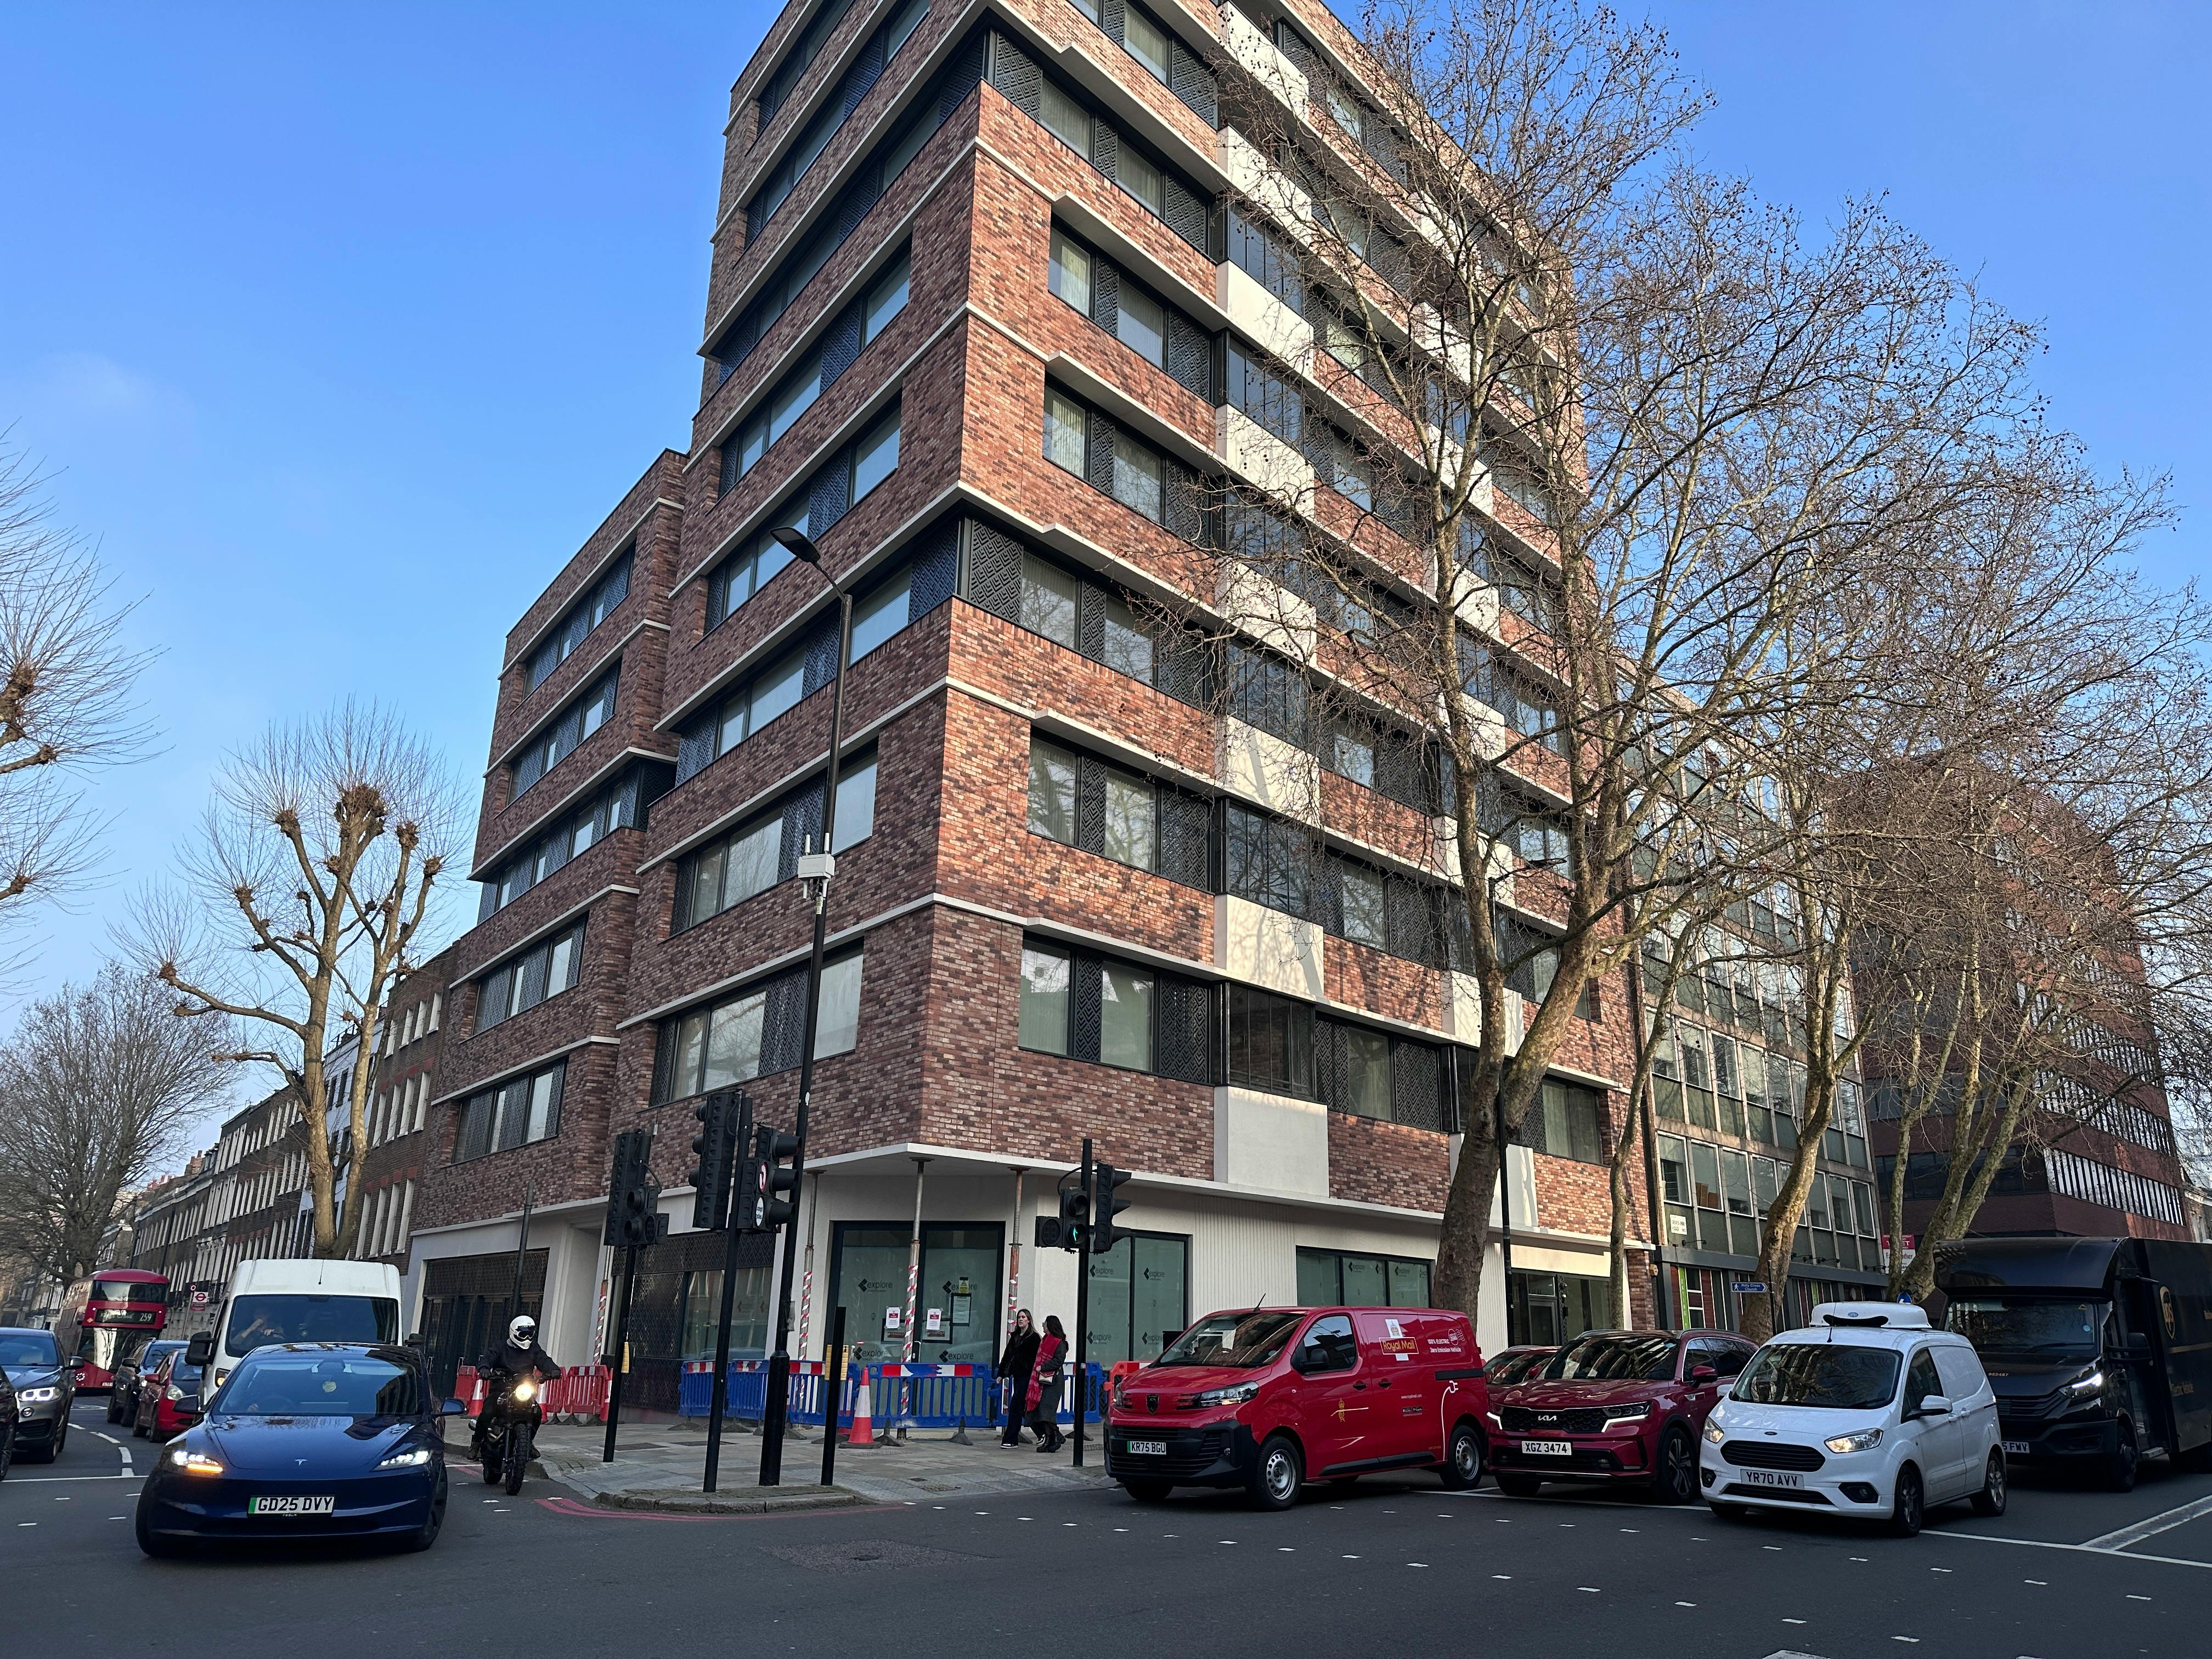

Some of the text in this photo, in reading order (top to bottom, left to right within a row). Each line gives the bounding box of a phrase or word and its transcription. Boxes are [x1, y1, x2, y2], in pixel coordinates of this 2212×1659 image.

[1095, 1267, 1114, 1275] explore
[867, 1280, 893, 1290] explore
[139, 1313, 152, 1322] 259
[1093, 1334, 1111, 1342] explore
[1382, 1339, 1416, 1351] Royal Mail
[861, 1349, 889, 1358] explore
[948, 1351, 974, 1360] explore
[1131, 1442, 1165, 1453] KR75 BGU
[1525, 1443, 1567, 1453] XGZ 3474
[2010, 1443, 2027, 1452] FWV
[1746, 1471, 1797, 1487] YR70 AVV
[258, 1497, 333, 1511] GD25 DVY
